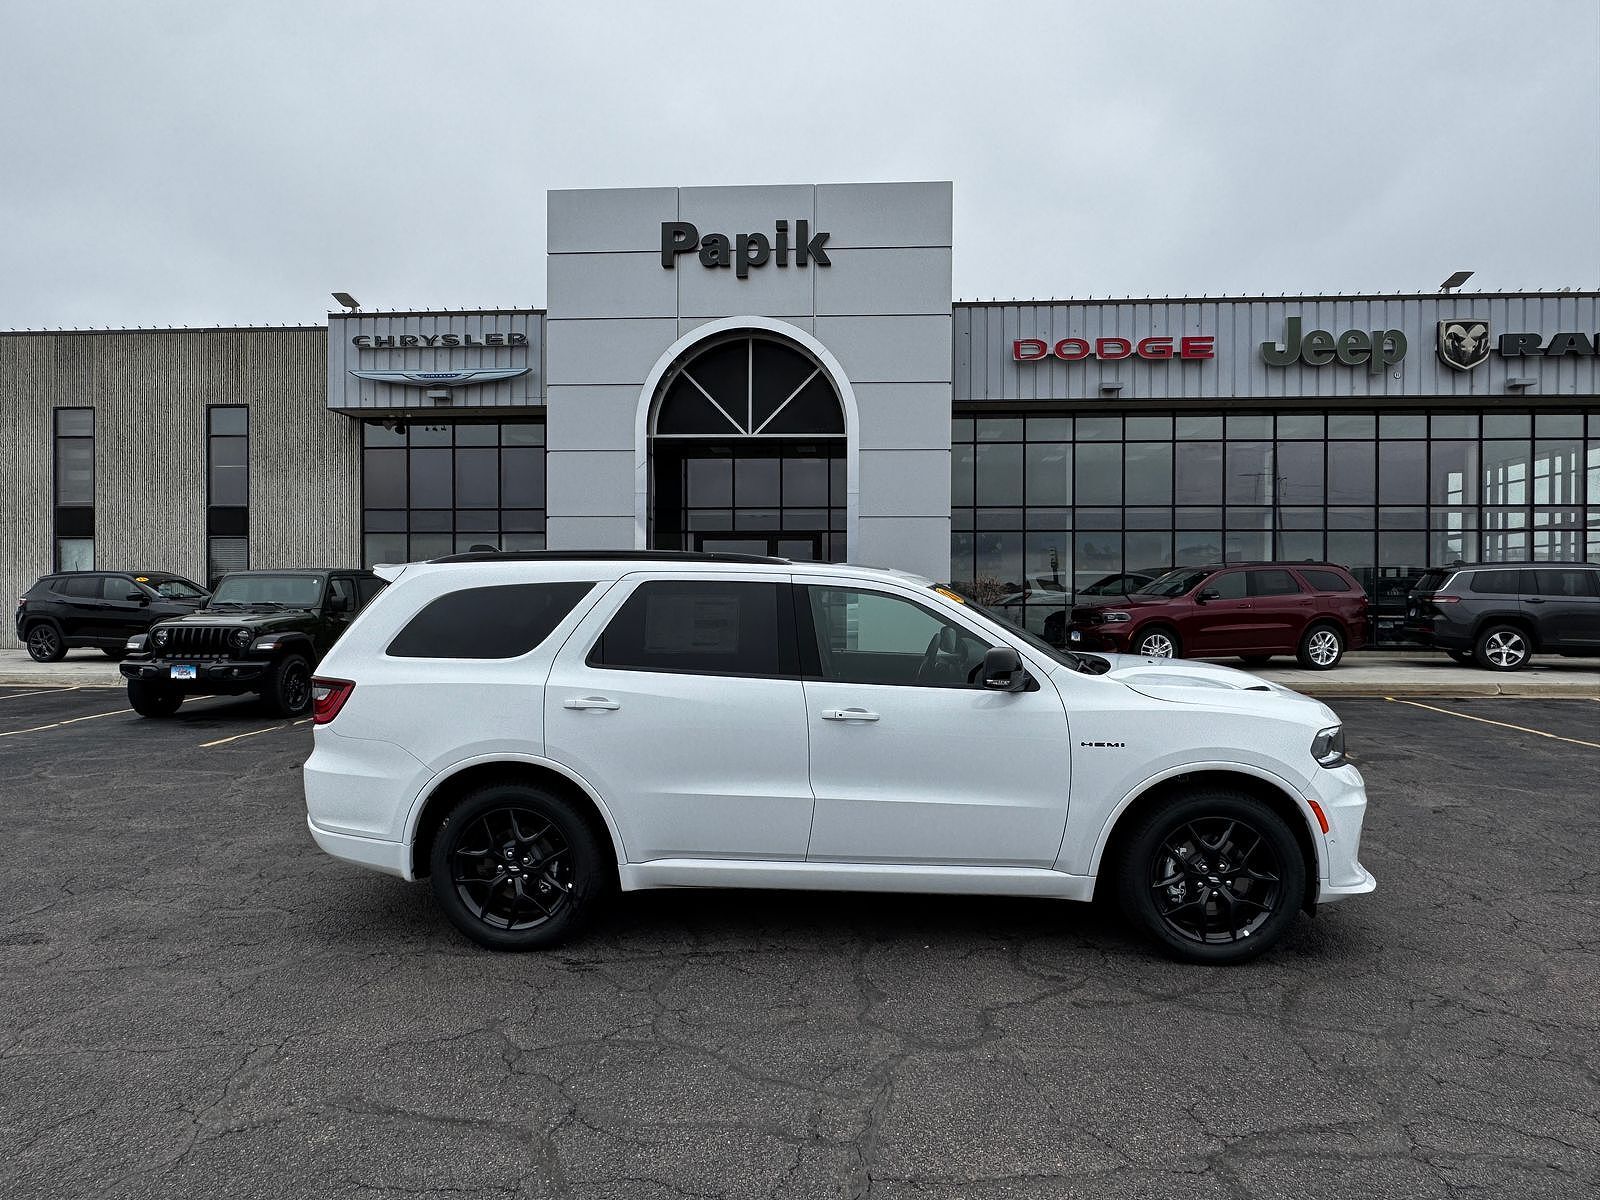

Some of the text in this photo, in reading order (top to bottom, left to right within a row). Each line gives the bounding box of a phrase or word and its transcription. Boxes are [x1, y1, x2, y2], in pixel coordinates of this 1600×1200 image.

[661, 219, 832, 279] Papik
[352, 332, 528, 349] CHRYSLER
[1013, 336, 1215, 361] DODGE
[1262, 316, 1408, 375] Jeep
[1499, 332, 1600, 357] RA
